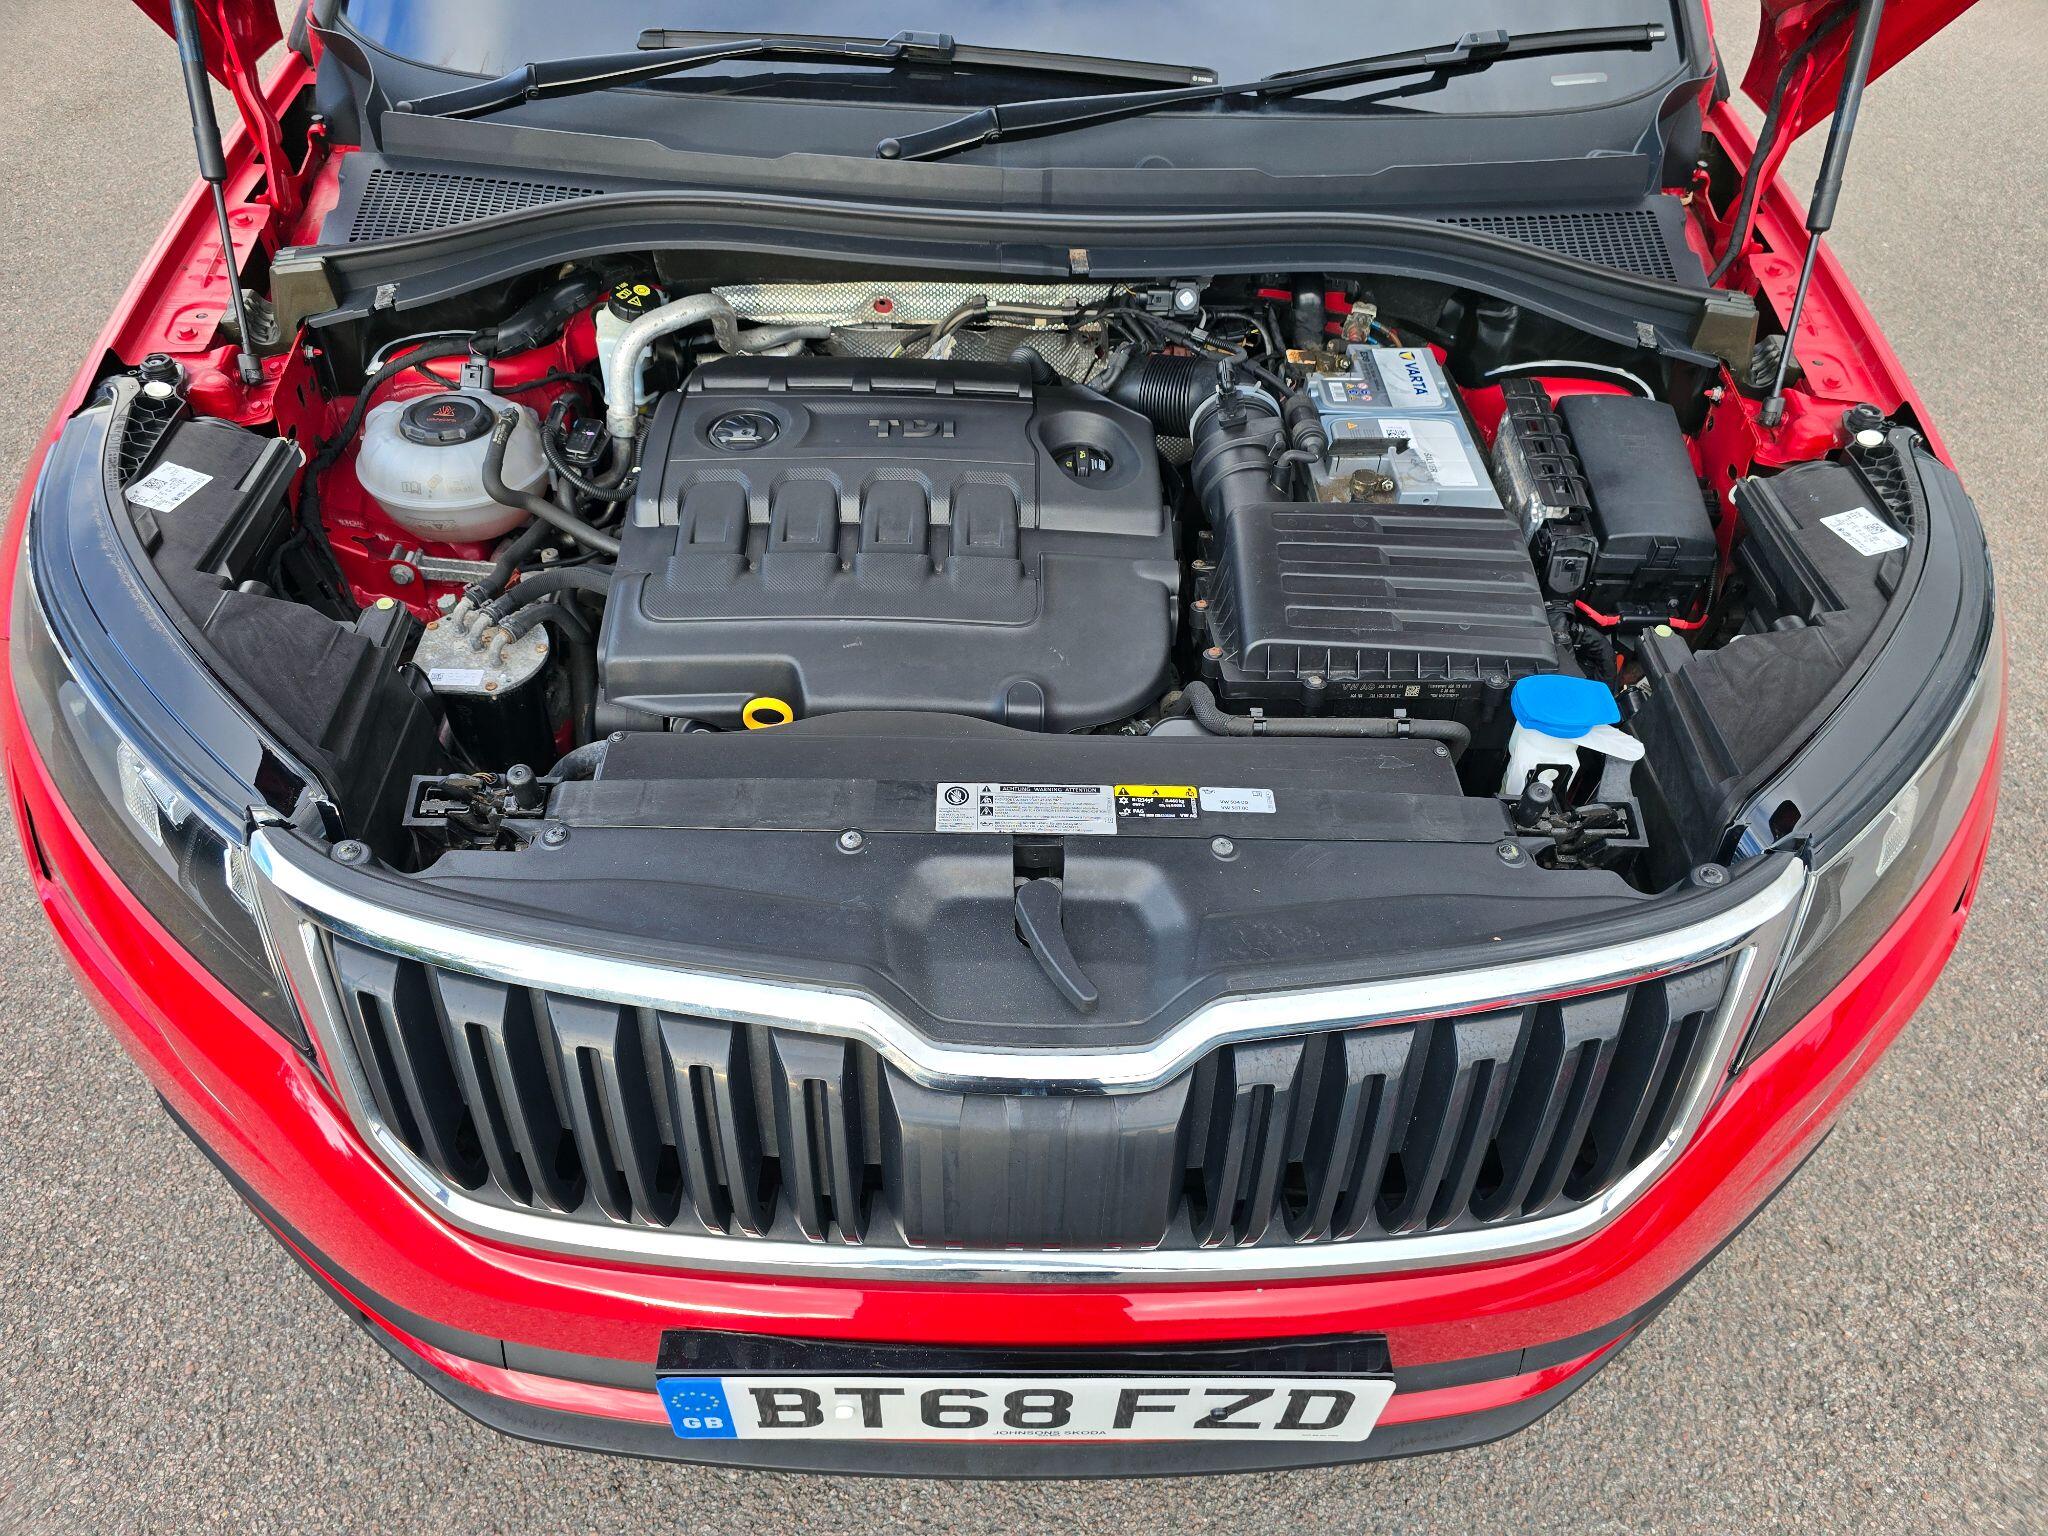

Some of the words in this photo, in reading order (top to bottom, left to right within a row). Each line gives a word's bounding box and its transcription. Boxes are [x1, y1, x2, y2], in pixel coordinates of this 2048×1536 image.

[1404, 362, 1428, 396] VARTA
[868, 419, 955, 438] TDI
[748, 1386, 1076, 1431] BT68
[1112, 1387, 1355, 1430] FZD
[683, 1417, 724, 1430] GB
